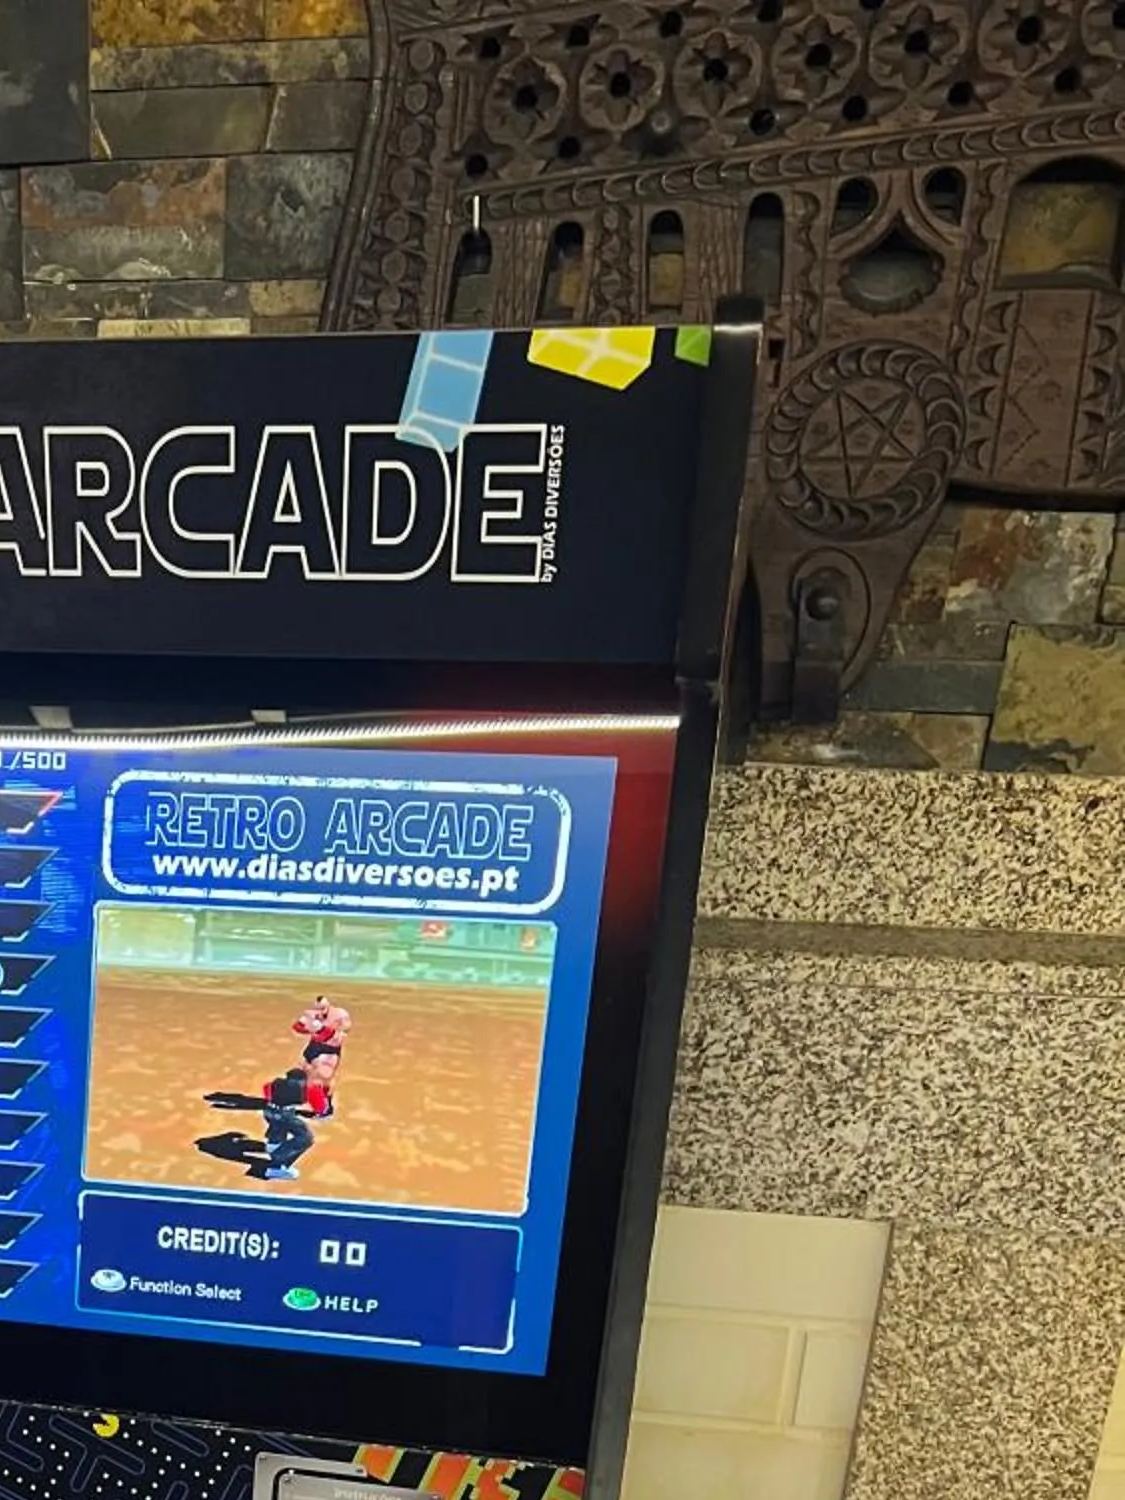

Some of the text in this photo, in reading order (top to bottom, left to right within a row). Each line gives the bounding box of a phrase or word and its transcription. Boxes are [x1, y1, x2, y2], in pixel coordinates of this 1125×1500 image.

[542, 522, 557, 561] DIAS
[540, 562, 557, 583] by
[144, 791, 535, 862] RETRO ARCADE
[151, 851, 520, 898] www.diasdiversoes.pt
[156, 1225, 280, 1260] CREDIT(S):
[128, 1276, 243, 1302] Function Select
[323, 1294, 380, 1315] HELP
